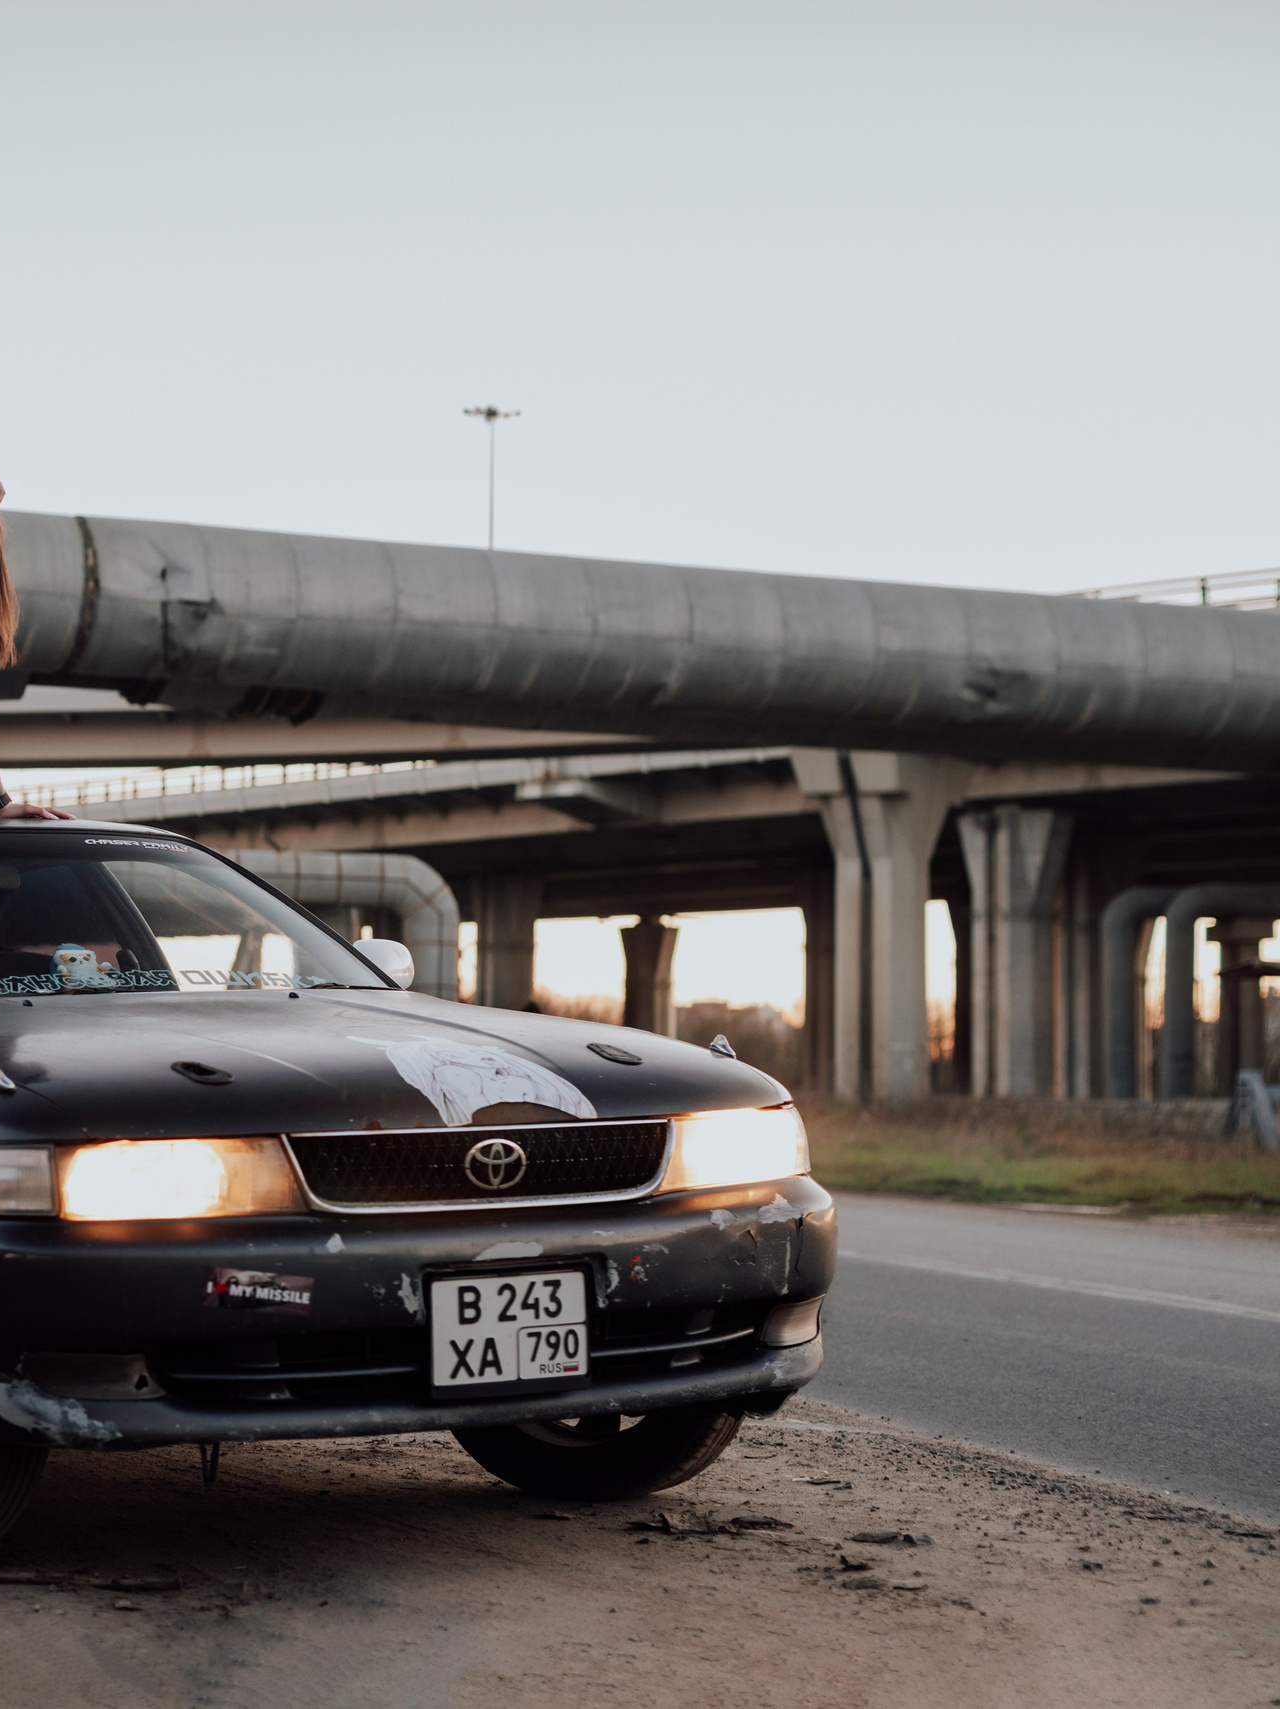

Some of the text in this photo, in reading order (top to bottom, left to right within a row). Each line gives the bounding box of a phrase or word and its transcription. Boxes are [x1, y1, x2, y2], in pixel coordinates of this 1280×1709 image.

[229, 1284, 254, 1297] MY
[255, 1287, 311, 1304] MISSILE
[497, 1280, 562, 1322] 243
[527, 1329, 579, 1362] 790
[540, 1363, 562, 1374] RUS
